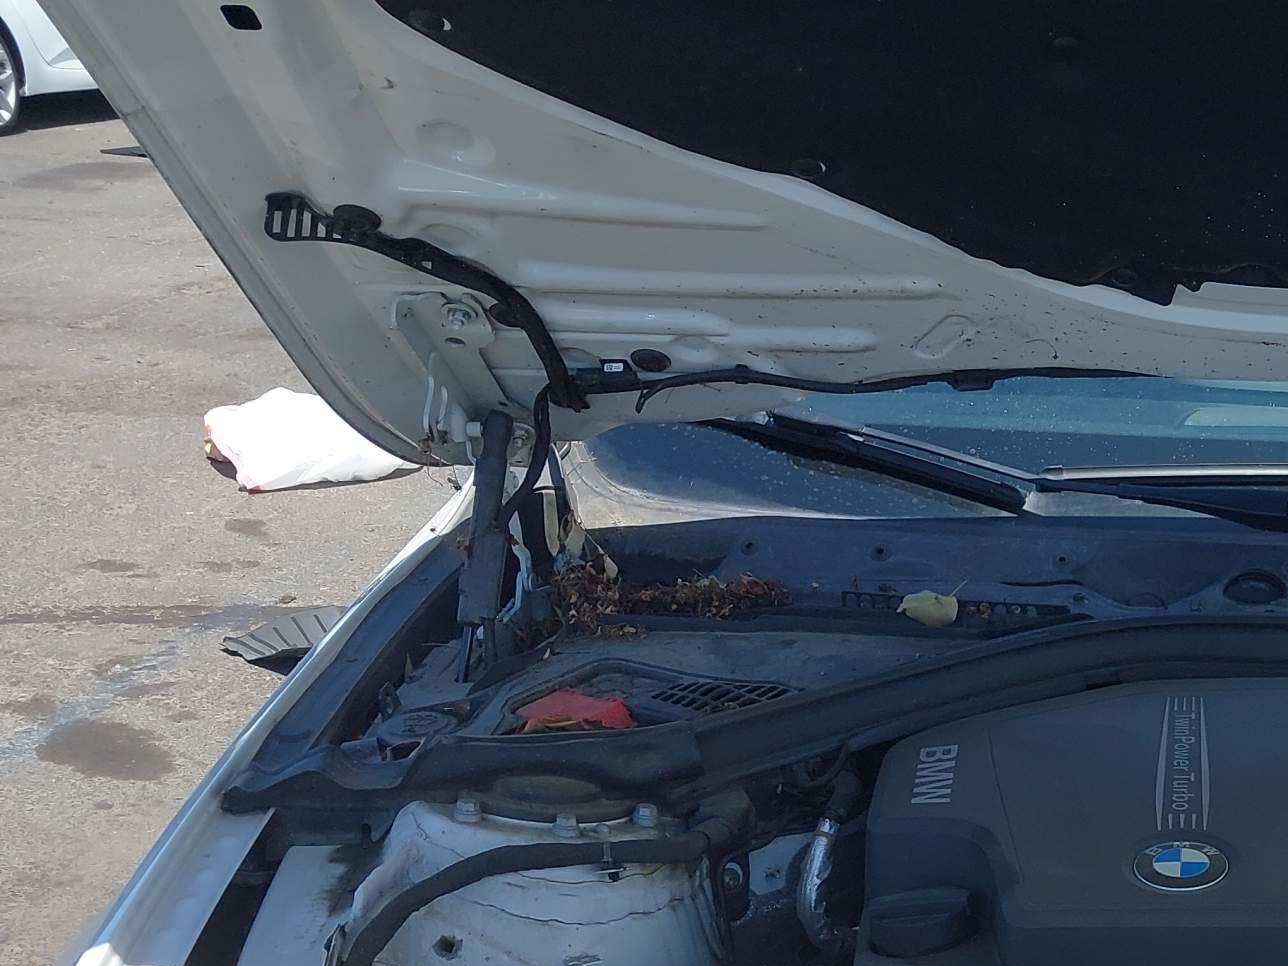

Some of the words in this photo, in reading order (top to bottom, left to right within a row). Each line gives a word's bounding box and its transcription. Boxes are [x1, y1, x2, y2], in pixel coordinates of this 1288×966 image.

[1173, 712, 1196, 771] TwinPower
[911, 744, 959, 804] BMW
[1171, 772, 1195, 811] Turbo
[1143, 841, 1221, 856] BMW
